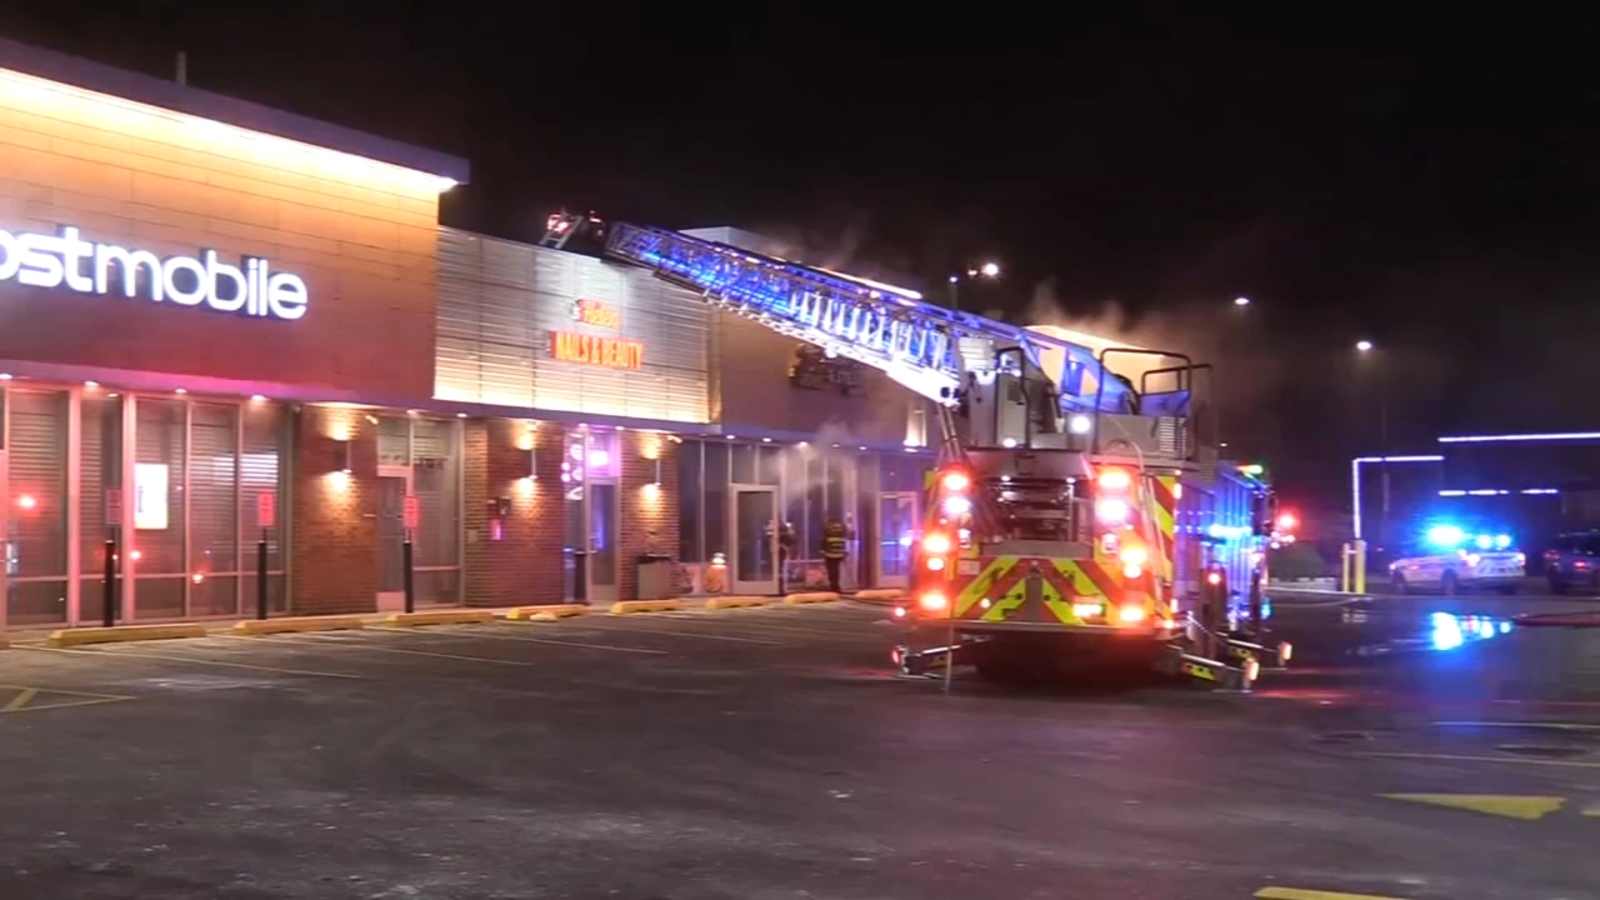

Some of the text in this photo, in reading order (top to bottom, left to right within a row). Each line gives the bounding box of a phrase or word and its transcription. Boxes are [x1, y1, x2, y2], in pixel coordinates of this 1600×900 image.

[554, 332, 644, 370] NAILS & BEAUTY
